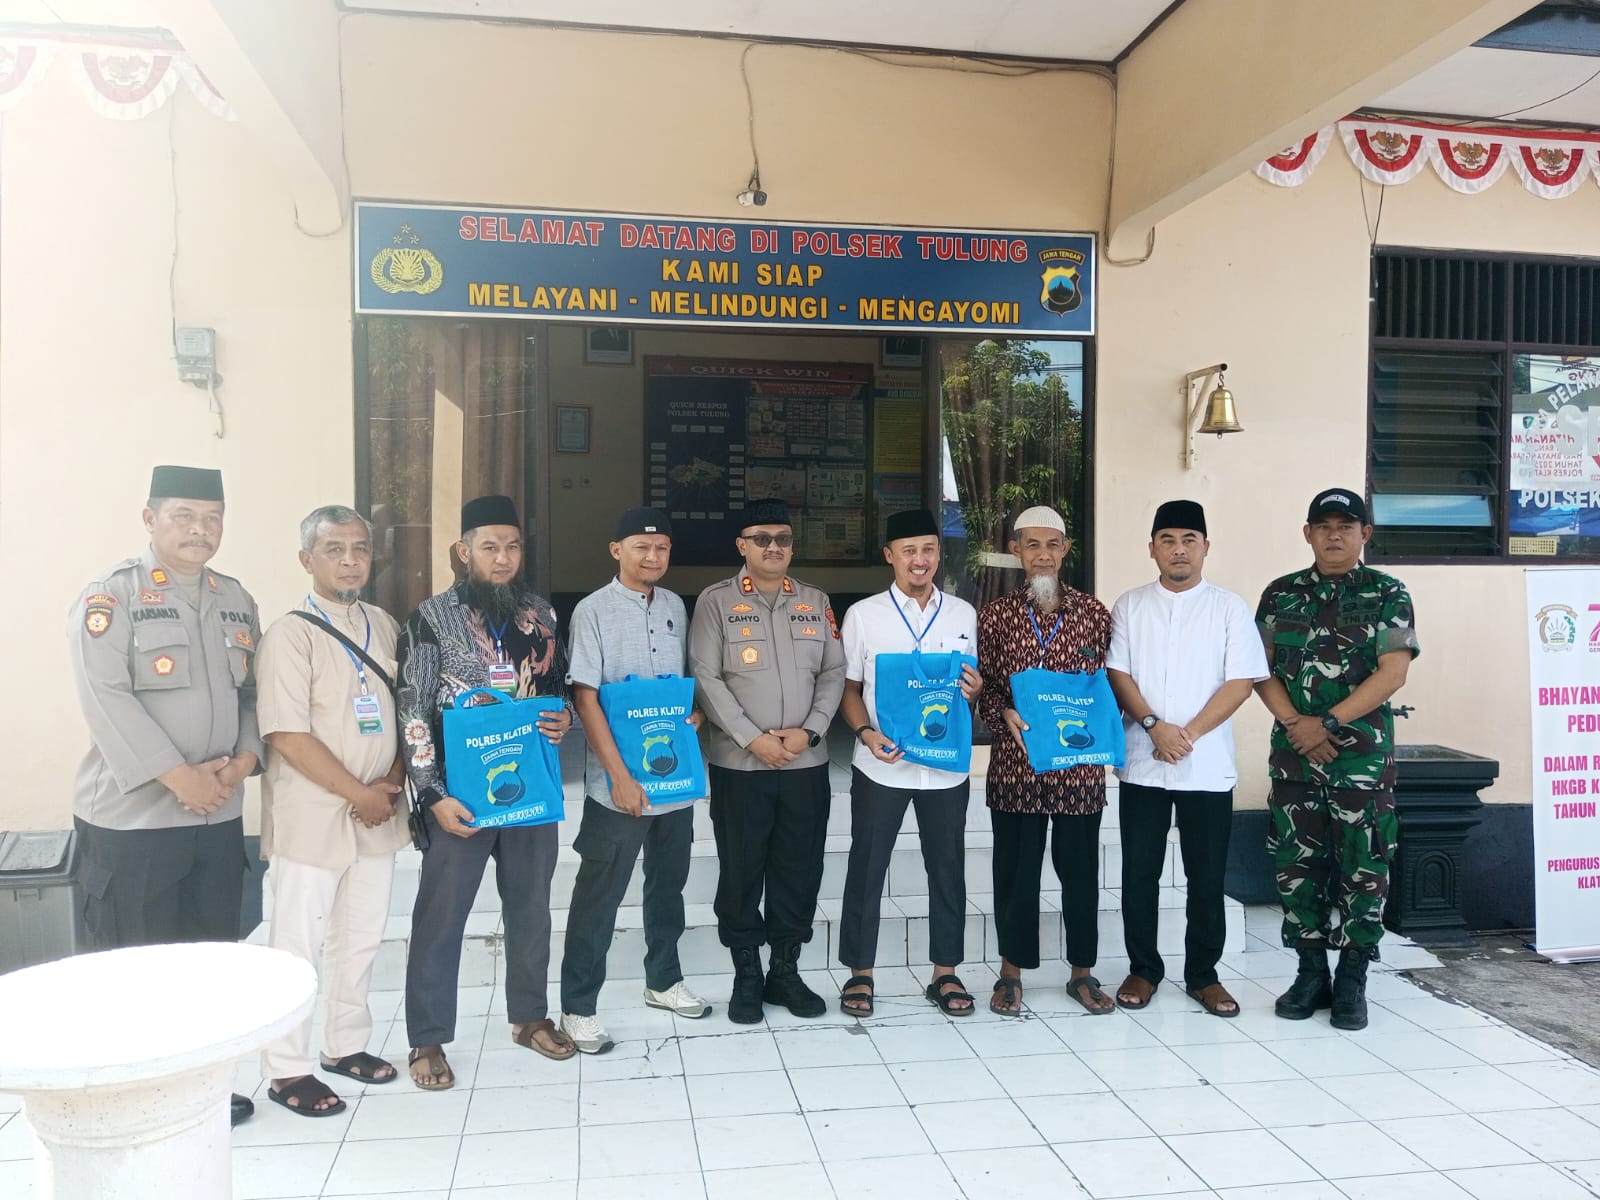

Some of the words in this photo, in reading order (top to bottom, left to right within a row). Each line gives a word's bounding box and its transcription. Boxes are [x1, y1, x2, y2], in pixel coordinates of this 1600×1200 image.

[459, 215, 604, 247] SELAMAT
[620, 223, 736, 252] DATANG
[750, 229, 778, 254] DI
[792, 230, 903, 258] POLSEK
[917, 236, 1028, 263] TULUNG
[1043, 251, 1058, 259] JAWA
[1059, 250, 1082, 261] TENGAH
[662, 259, 740, 285] KAMI
[756, 263, 823, 287] SIAP
[468, 283, 618, 311] MELAYANI
[650, 290, 828, 319] MELINDUNGI
[858, 297, 1020, 325] MENGAYOMI
[690, 364, 772, 376] QUICK
[783, 367, 832, 378] WIN
[728, 615, 760, 623] CAHYO
[790, 615, 821, 623] POLRI
[1037, 694, 1066, 702] POLRES
[1066, 696, 1094, 706] KLATEN
[1538, 686, 1600, 705] BHAYAN
[627, 707, 659, 719] POLRES
[660, 706, 685, 716] KLATEN
[466, 734, 501, 749] POLRES
[503, 723, 532, 741] KLATEN
[1544, 756, 1588, 772] DALAM
[1552, 779, 1587, 796] HKGB
[1553, 802, 1596, 819] TAHUN
[1548, 857, 1600, 872] PENGURUS
